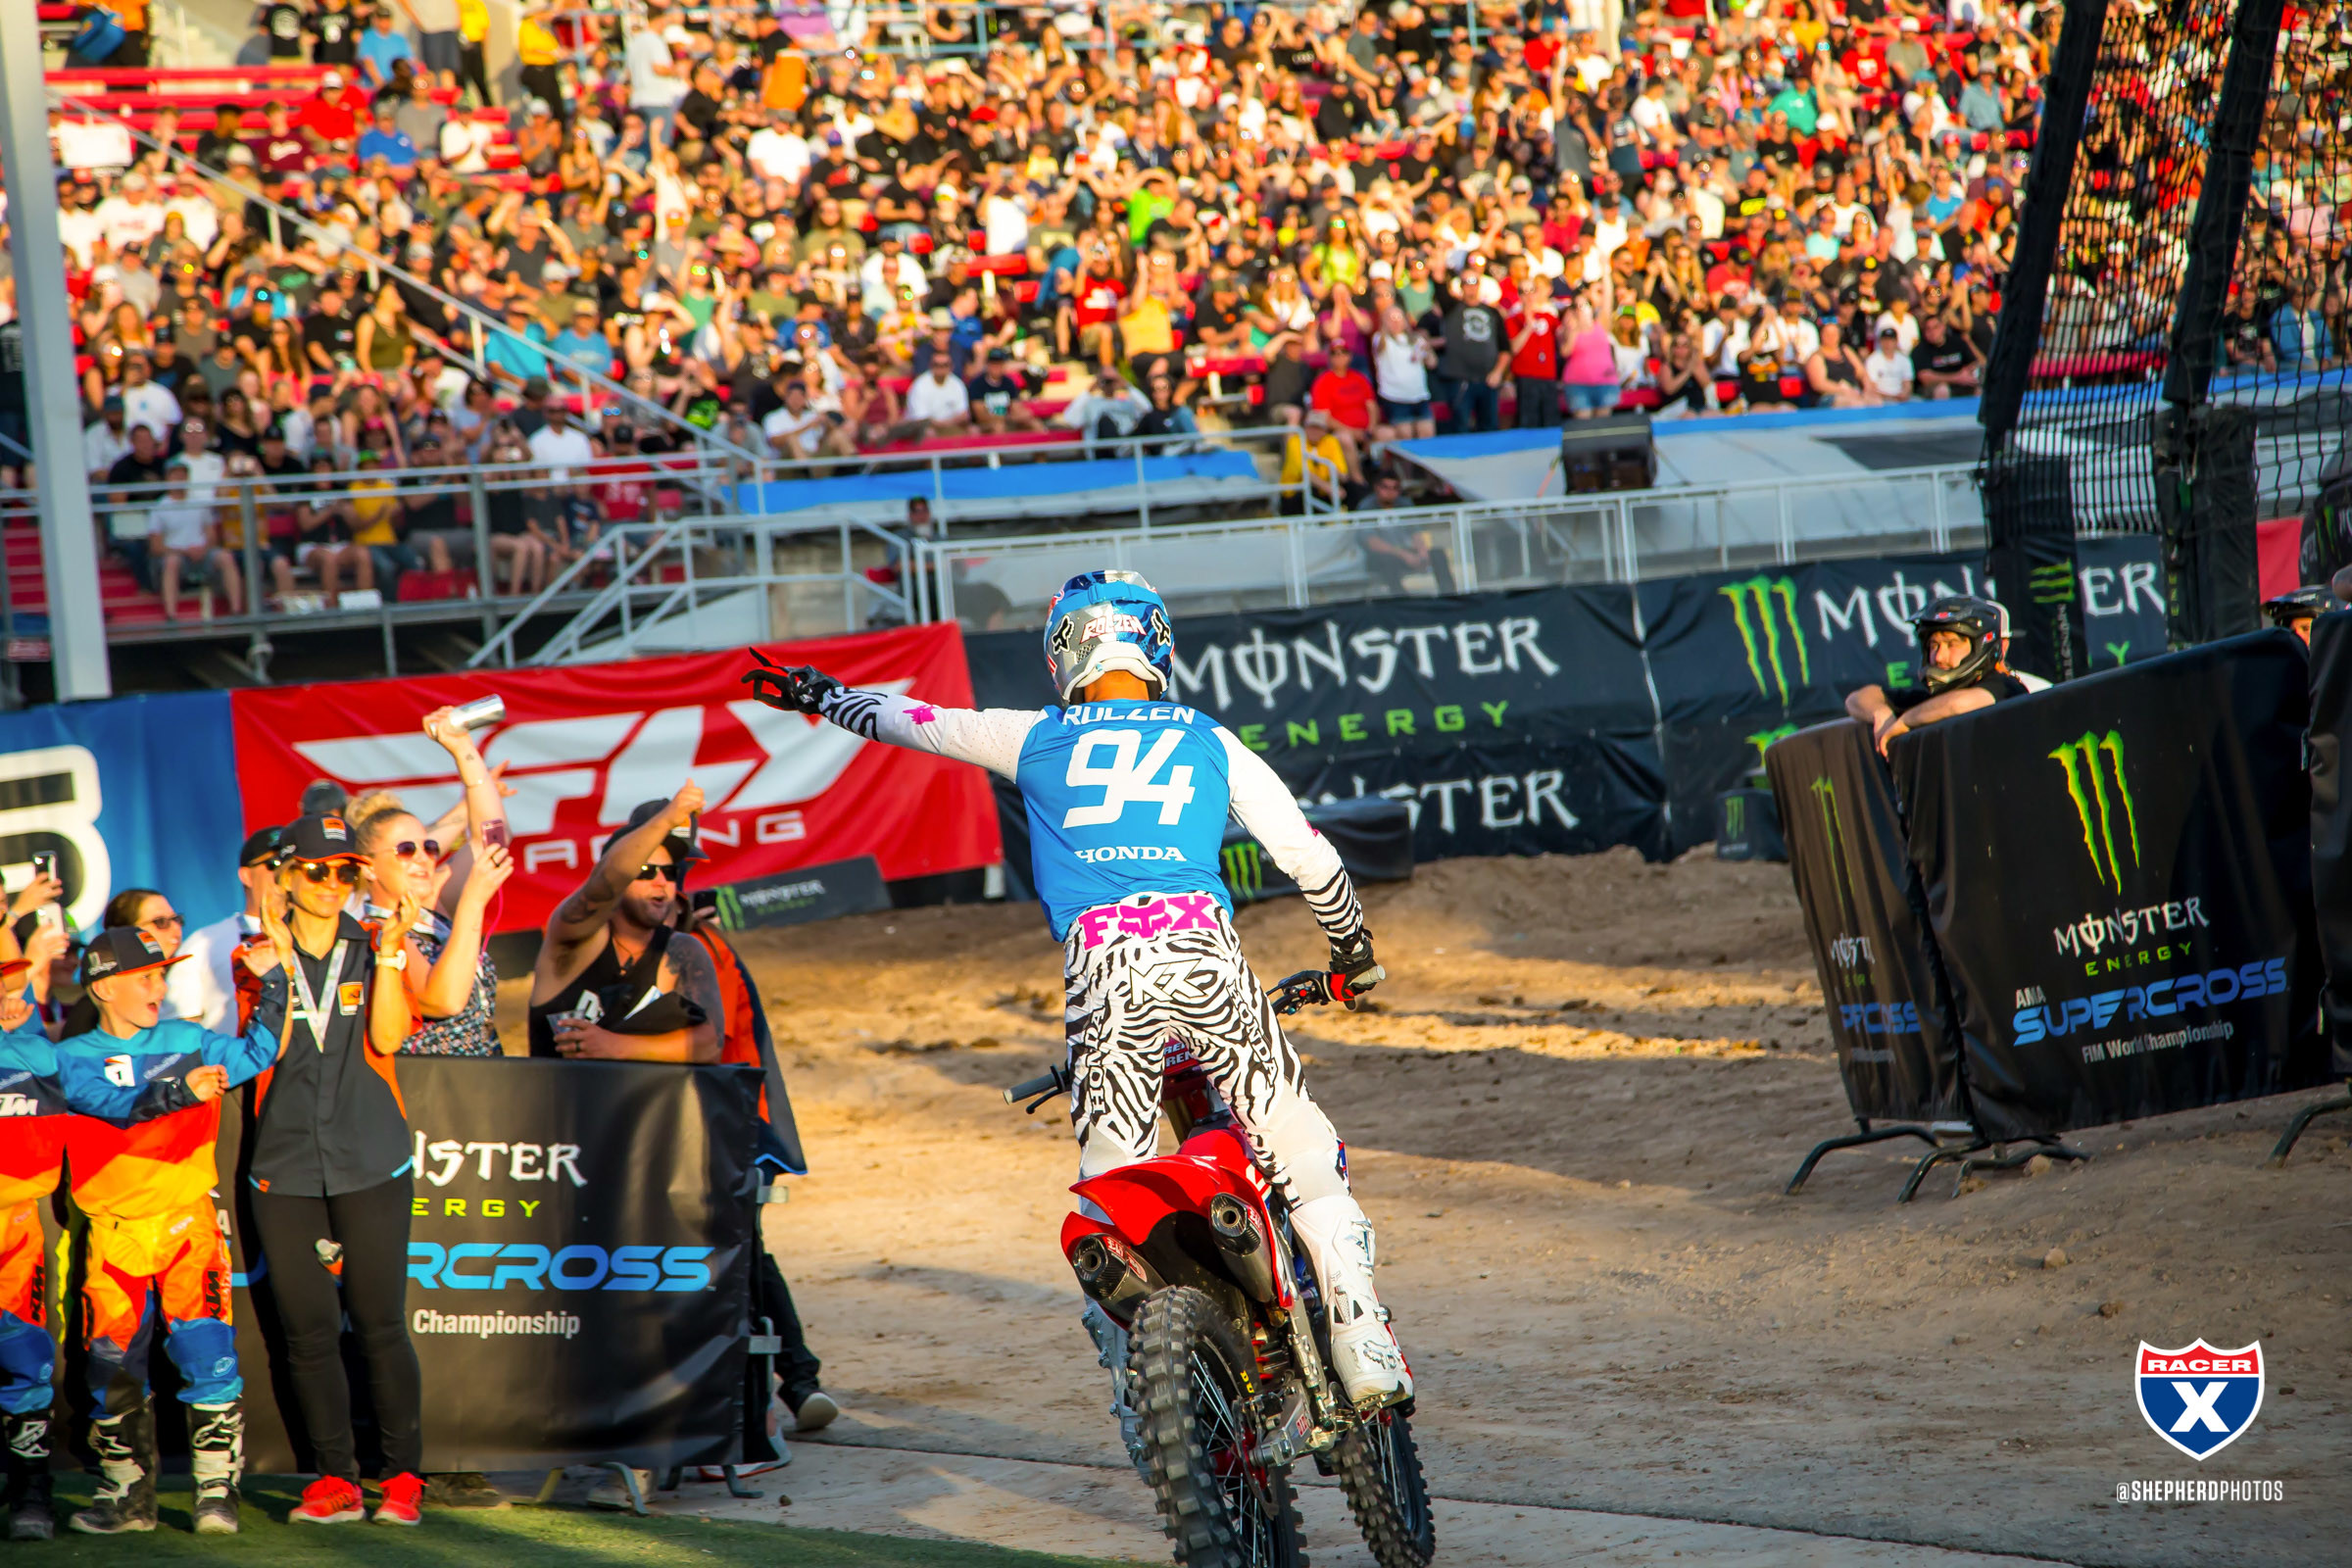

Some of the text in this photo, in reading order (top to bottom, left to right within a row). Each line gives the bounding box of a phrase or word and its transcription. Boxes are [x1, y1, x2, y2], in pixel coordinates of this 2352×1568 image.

[1168, 615, 1560, 710] MONSTER
[1239, 700, 1509, 752] ENERGY
[1062, 728, 1196, 829] 94
[1074, 846, 1187, 863] HONDA
[1078, 895, 1219, 951] FOX
[2052, 896, 2210, 957] MONSTER
[2084, 941, 2192, 977] ENERGY
[2013, 956, 2288, 1047] SUPERCROSS
[2081, 1046, 2105, 1064] FIM
[413, 1308, 581, 1339] Championship
